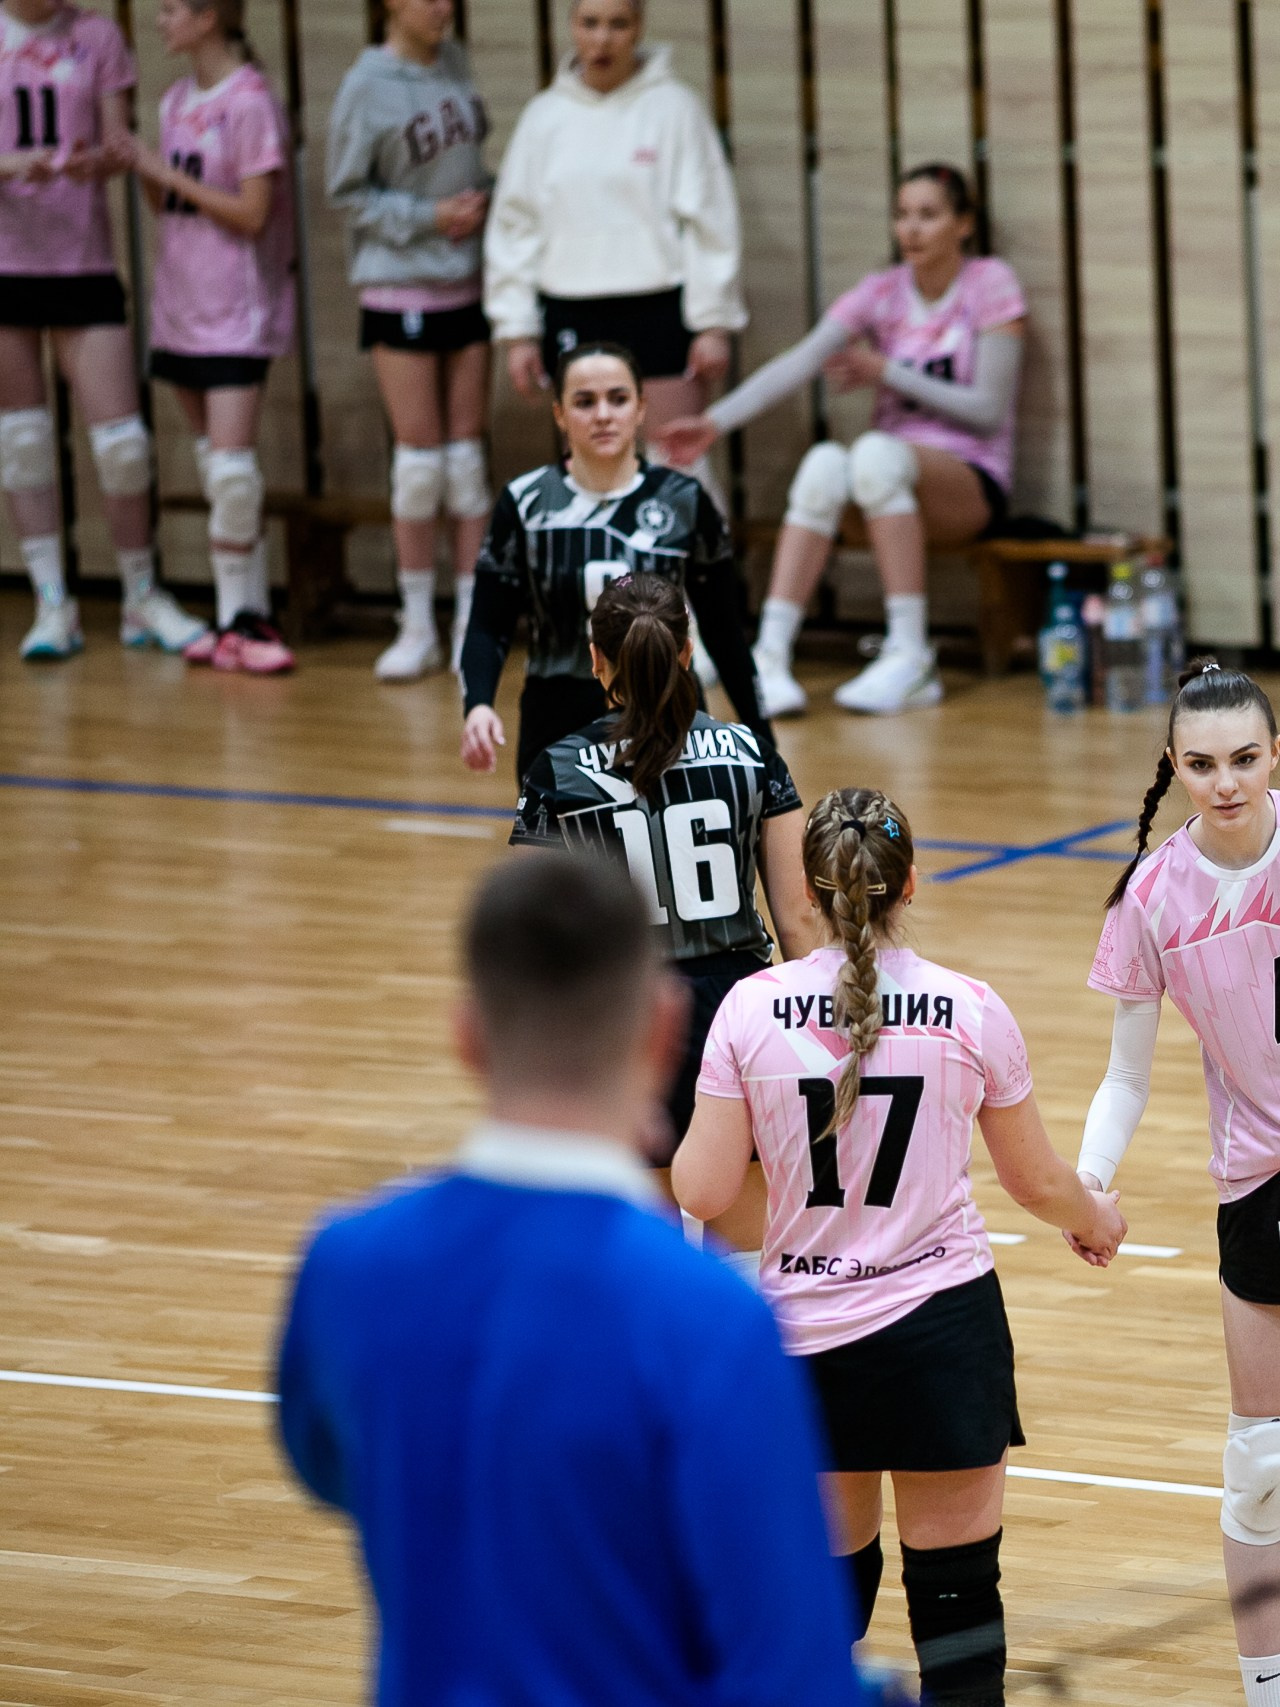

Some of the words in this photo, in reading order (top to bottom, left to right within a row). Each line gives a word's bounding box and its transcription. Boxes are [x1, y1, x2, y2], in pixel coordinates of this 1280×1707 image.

[15, 85, 57, 147] 11
[579, 728, 737, 773] ЧУИЯ
[612, 799, 740, 925] 16
[773, 993, 953, 1030] ЧУВШИЯ
[798, 1076, 925, 1209] 17
